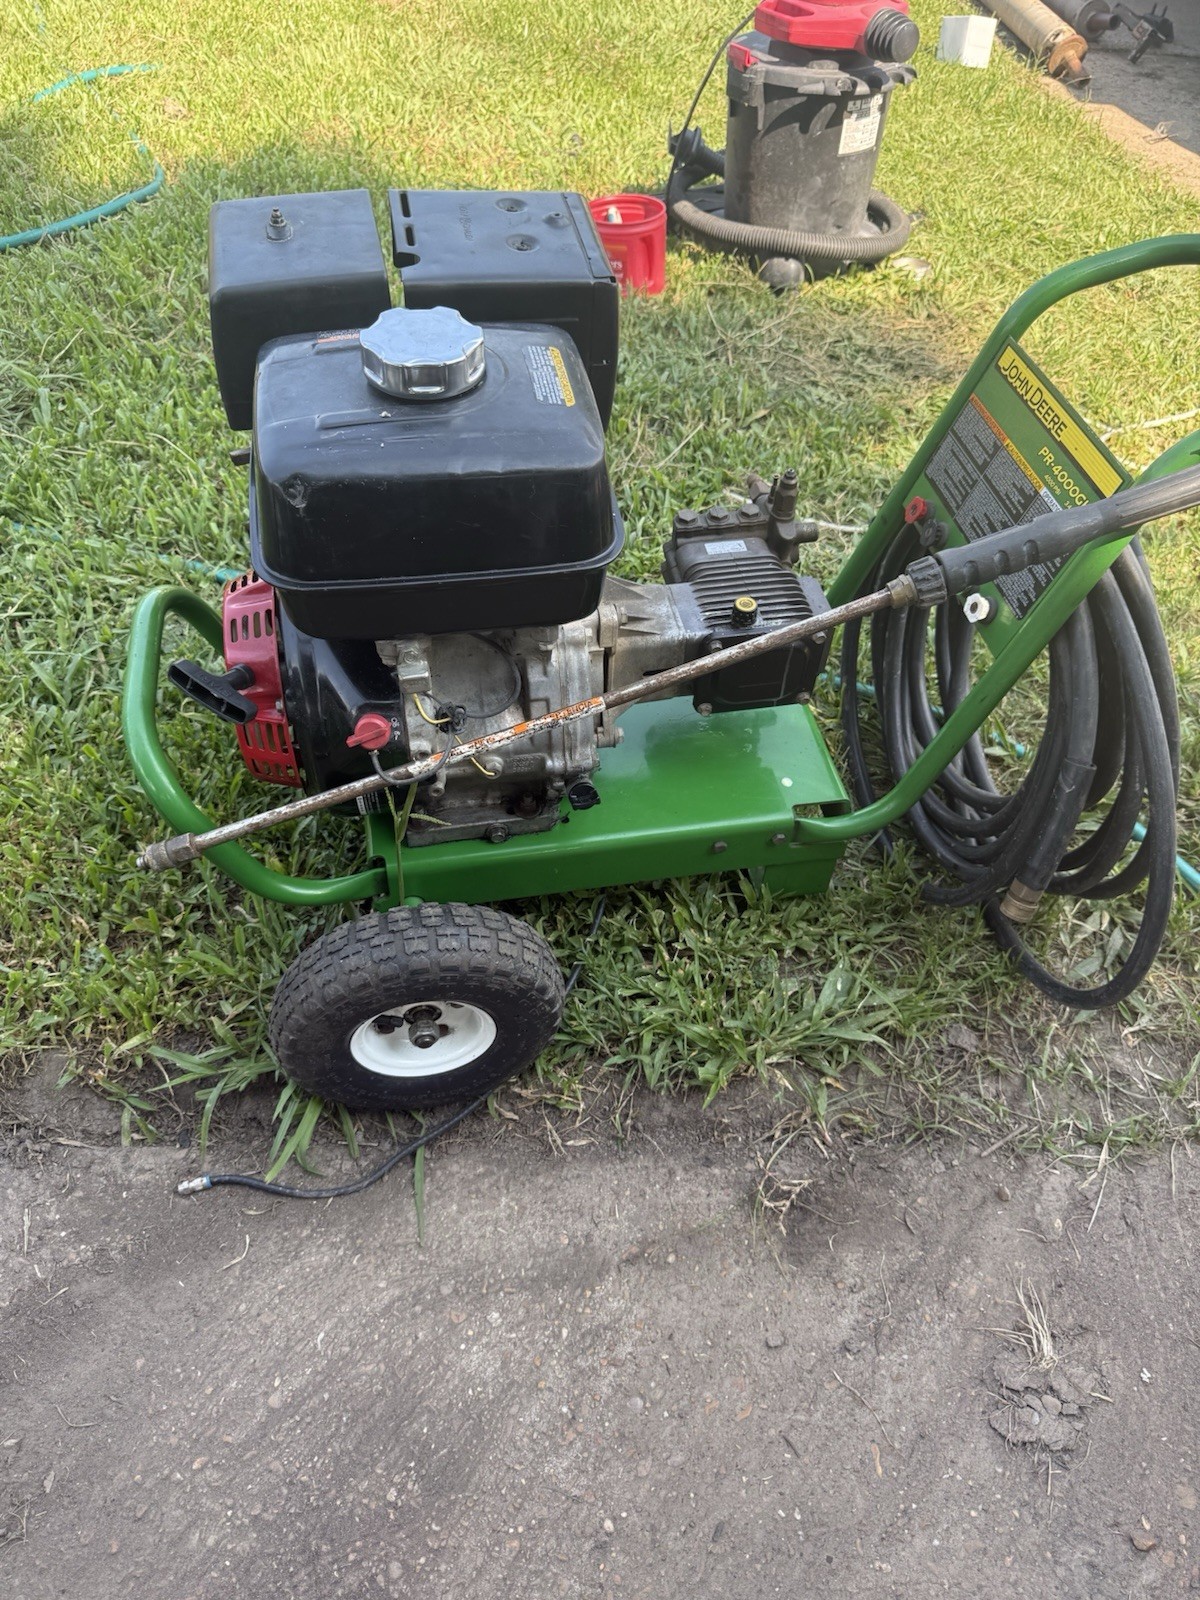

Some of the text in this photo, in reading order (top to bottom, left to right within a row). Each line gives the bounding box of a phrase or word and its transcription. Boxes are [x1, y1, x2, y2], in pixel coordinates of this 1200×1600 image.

[1002, 358, 1068, 438] JOHN DEERE
[1044, 474, 1056, 488] 4000
[1052, 485, 1062, 496] PSI
